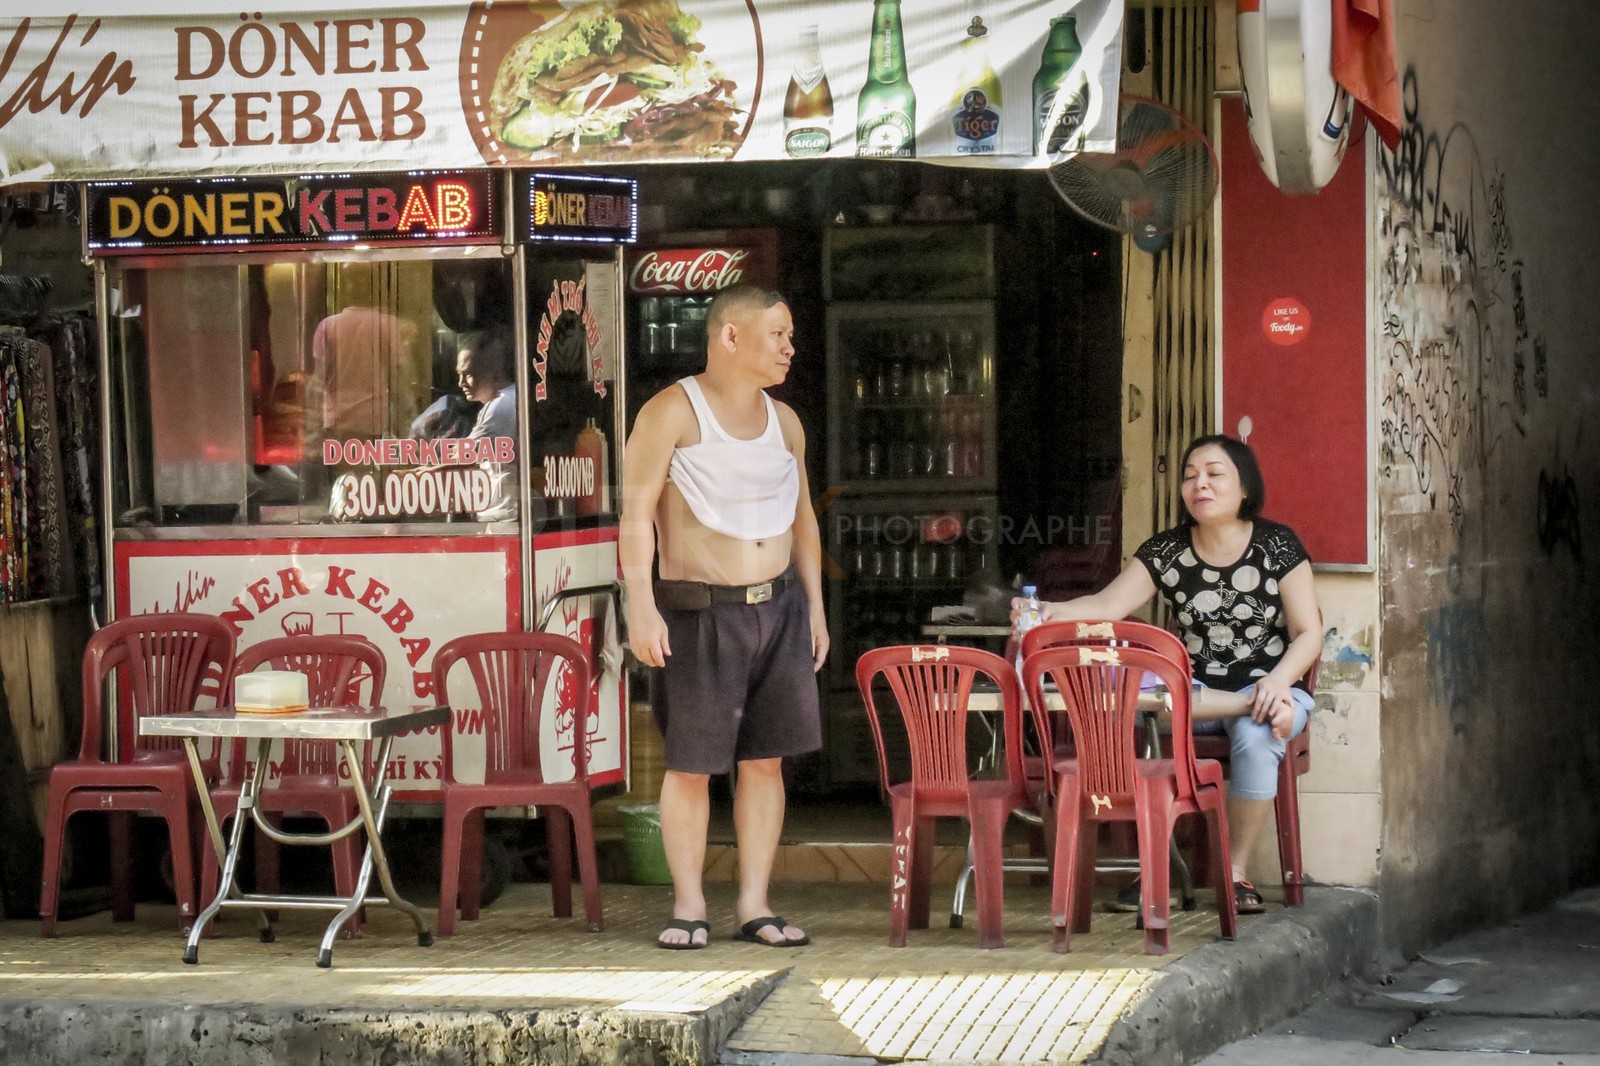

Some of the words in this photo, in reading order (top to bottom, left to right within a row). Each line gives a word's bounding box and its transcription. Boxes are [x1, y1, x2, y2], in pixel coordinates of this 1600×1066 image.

[174, 12, 430, 81] DÖNER
[177, 87, 427, 149] KEBAB
[955, 114, 998, 140] Tiger
[790, 137, 826, 149] SAIGON
[859, 146, 911, 158] Heineken
[110, 187, 286, 239] DÖNER
[301, 183, 473, 235] KEBAB
[631, 250, 749, 292] Coca-Cola
[1273, 308, 1288, 316] LIKE
[323, 437, 516, 466] DONERKEBAB
[344, 470, 493, 518] 30.000VNĐ
[544, 456, 594, 498] 30.000VNĐ
[325, 566, 437, 699] KEBAB
